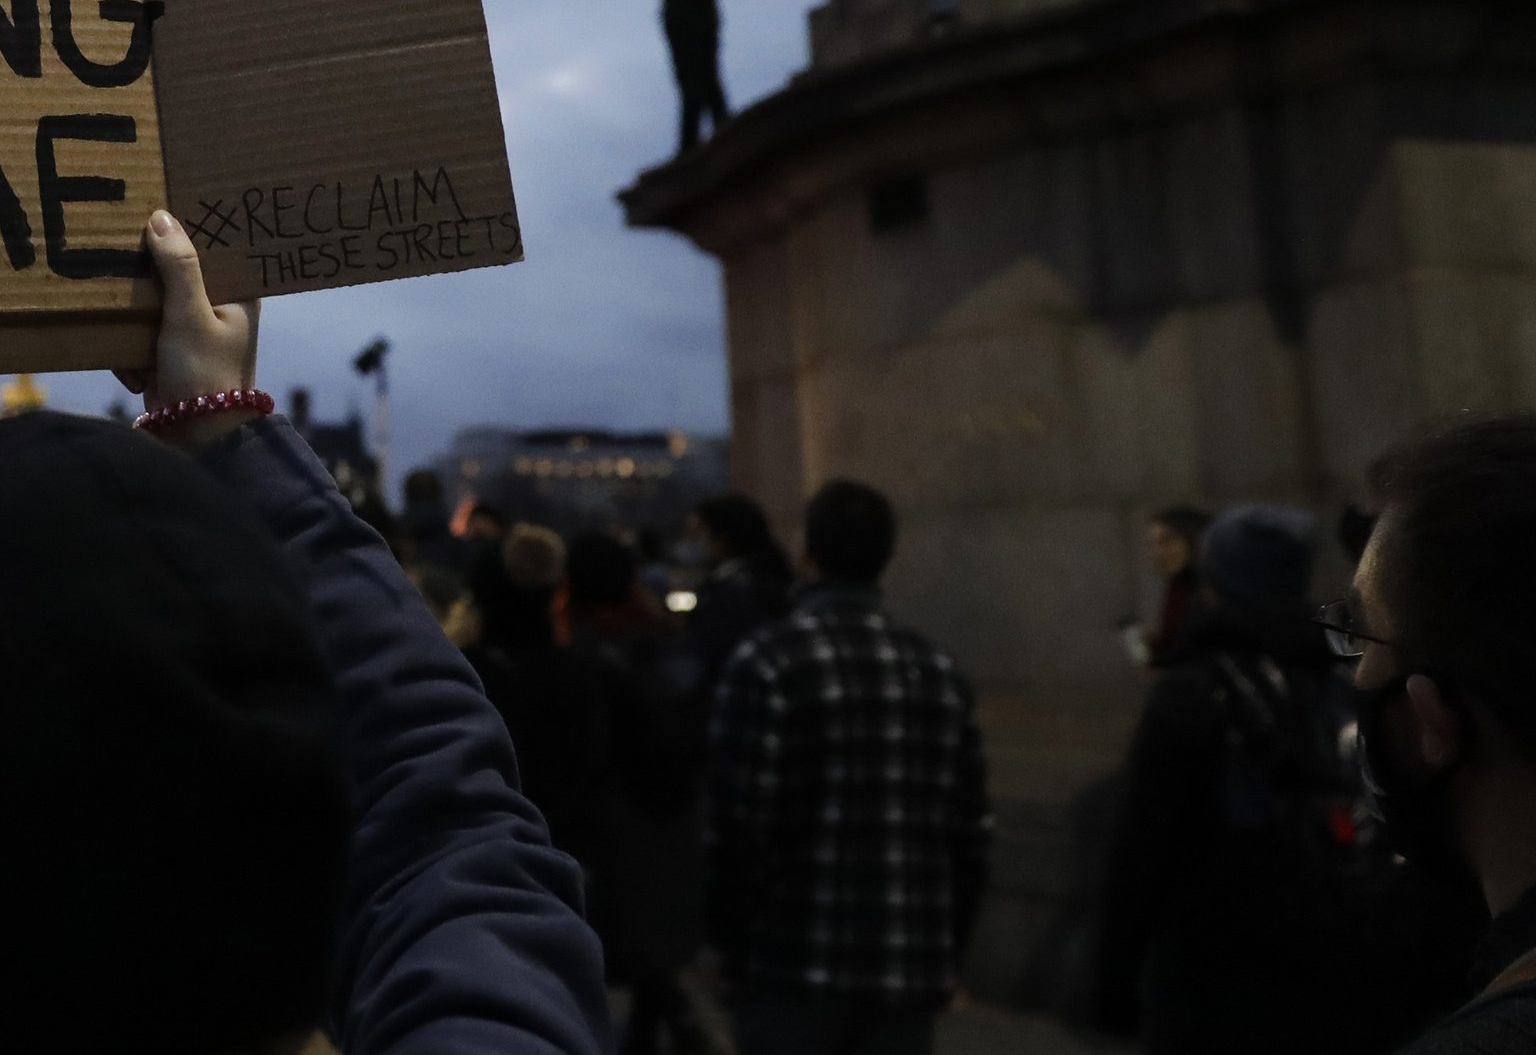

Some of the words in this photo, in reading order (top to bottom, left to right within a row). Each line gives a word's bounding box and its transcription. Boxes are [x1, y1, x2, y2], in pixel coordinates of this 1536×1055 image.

[184, 165, 470, 250] #RECLAIM
[246, 234, 365, 288] THESE
[376, 211, 522, 272] STREETS
